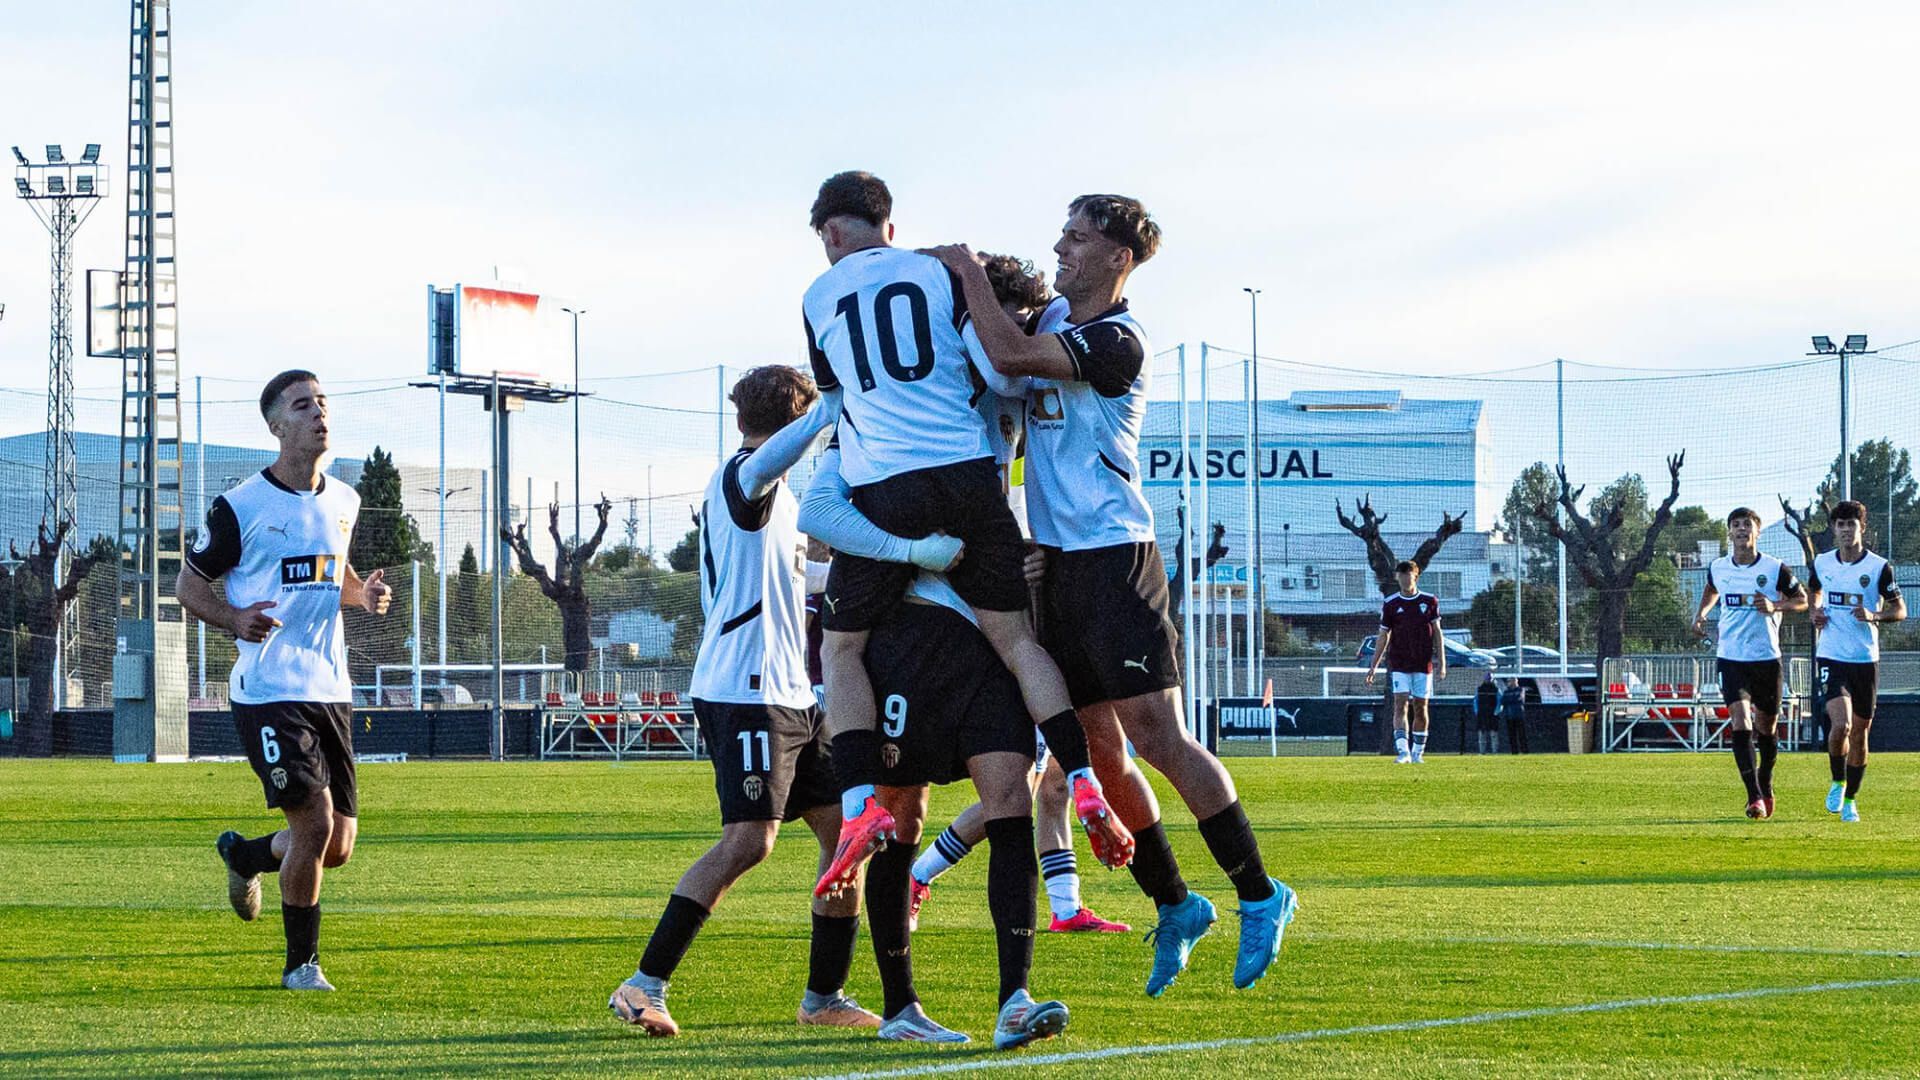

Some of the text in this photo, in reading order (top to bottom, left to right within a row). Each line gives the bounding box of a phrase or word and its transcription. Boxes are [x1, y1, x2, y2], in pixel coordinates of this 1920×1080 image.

[835, 281, 935, 392] 10
[1150, 449, 1333, 479] PASCUAL
[286, 563, 311, 578] TM
[1728, 596, 1740, 605] TM
[883, 694, 907, 737] 9
[1221, 707, 1276, 729] PUMA
[261, 726, 281, 763] 6
[737, 731, 770, 771] 11
